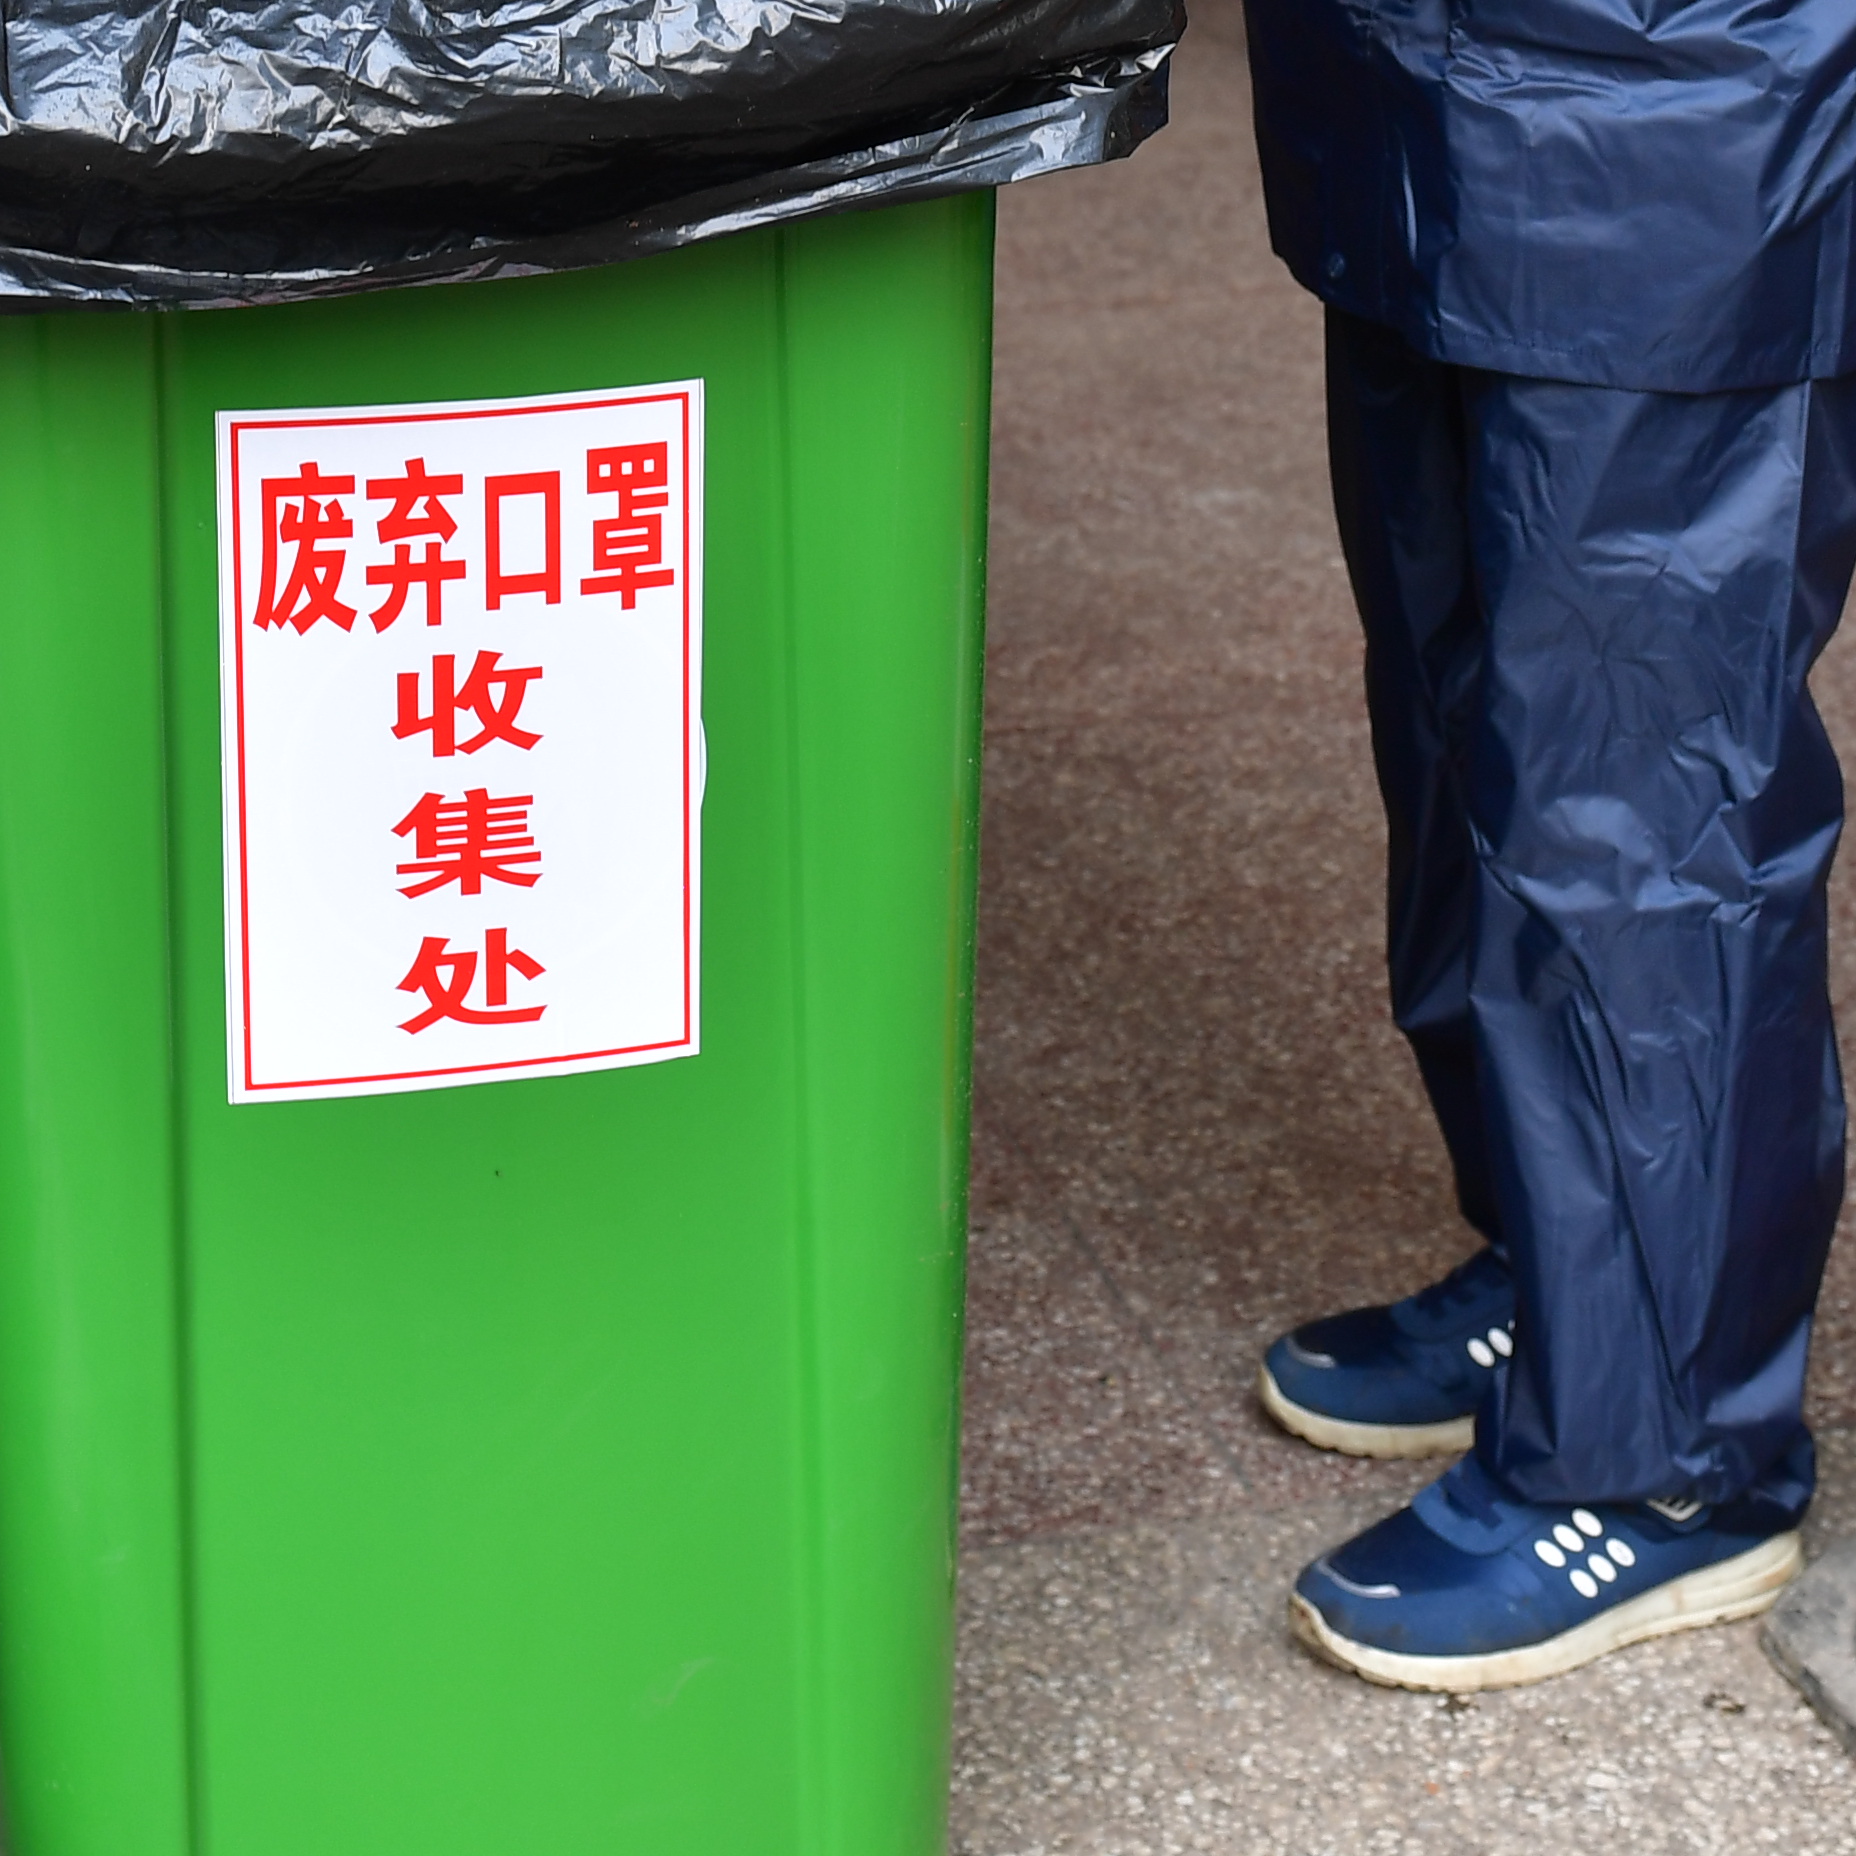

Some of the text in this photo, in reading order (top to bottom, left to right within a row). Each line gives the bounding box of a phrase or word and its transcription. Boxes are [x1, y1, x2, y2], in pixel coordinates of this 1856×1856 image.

[253, 441, 675, 635] 废弃口罩
[391, 649, 547, 1035] 收集处
